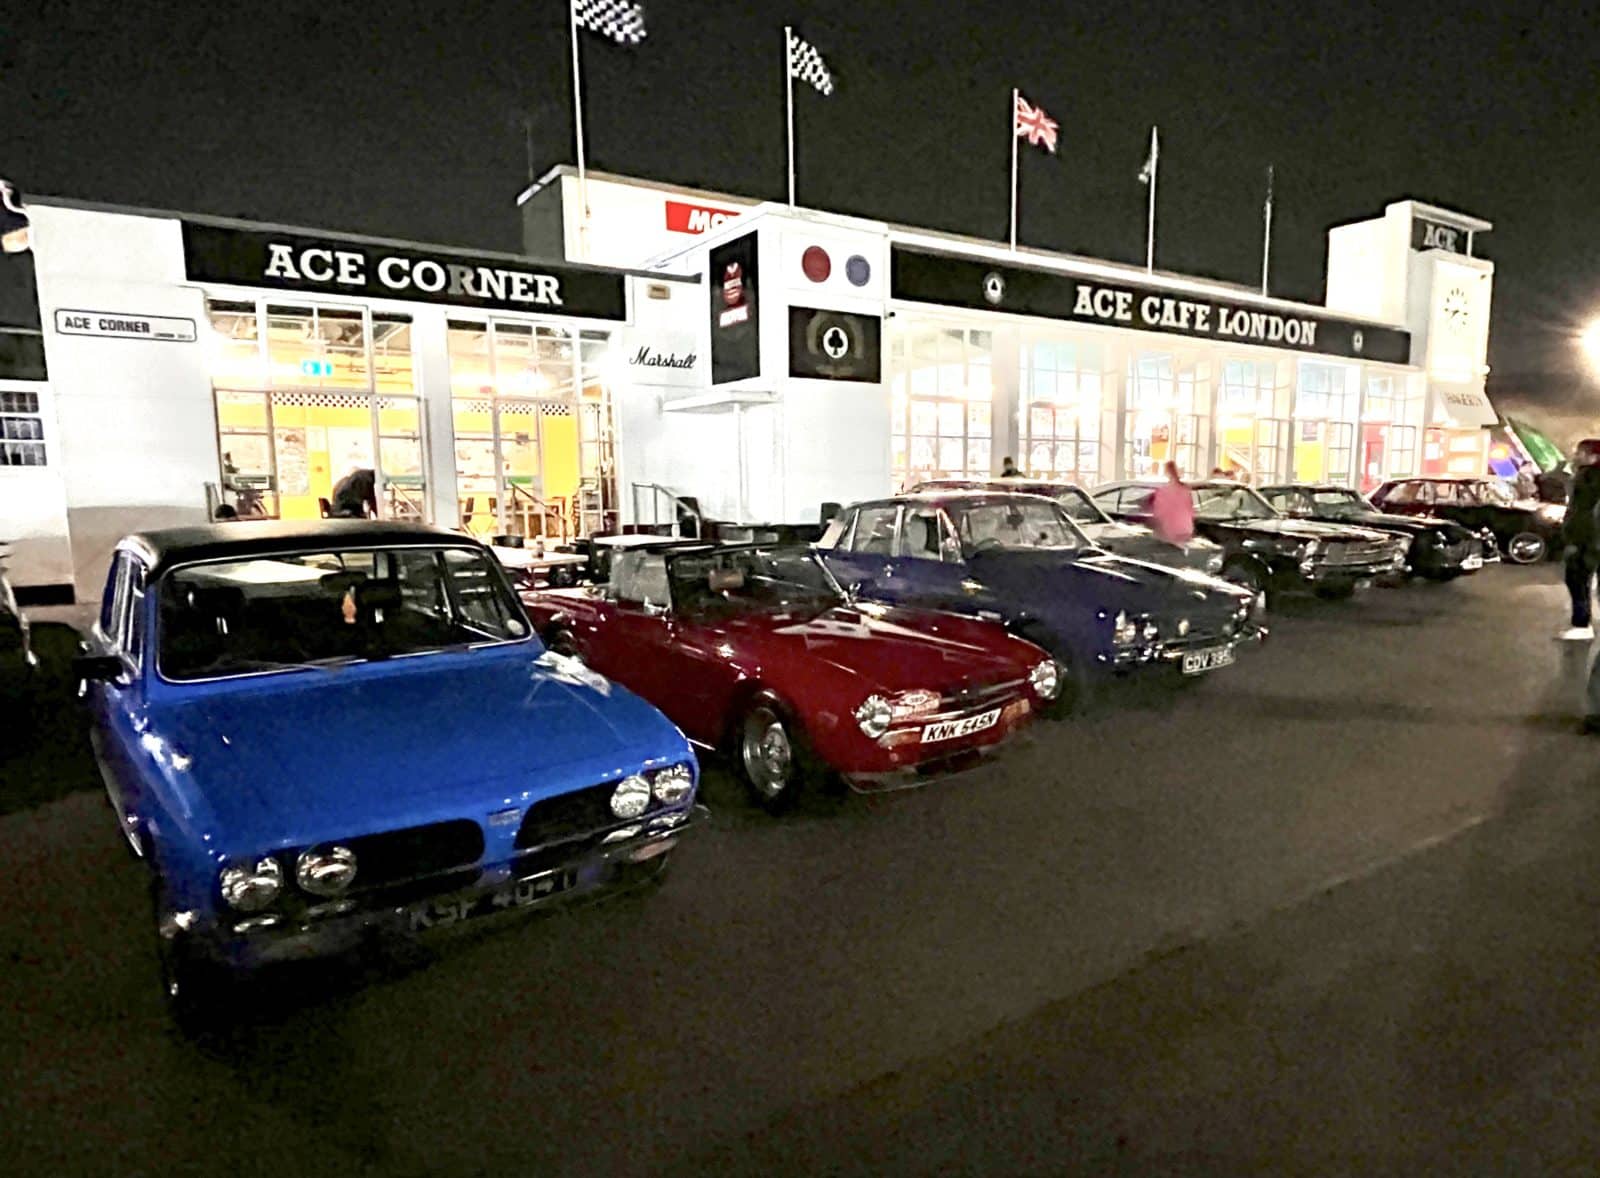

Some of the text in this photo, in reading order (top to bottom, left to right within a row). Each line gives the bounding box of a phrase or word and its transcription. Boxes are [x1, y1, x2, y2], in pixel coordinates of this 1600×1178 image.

[1424, 223, 1457, 252] ACE
[264, 243, 564, 306] ACE CORNER
[65, 316, 150, 333] ACE CORNER
[1074, 285, 1318, 345] ACE CAFE LONDON
[629, 345, 697, 369] Marshall
[926, 722, 958, 740] KNK
